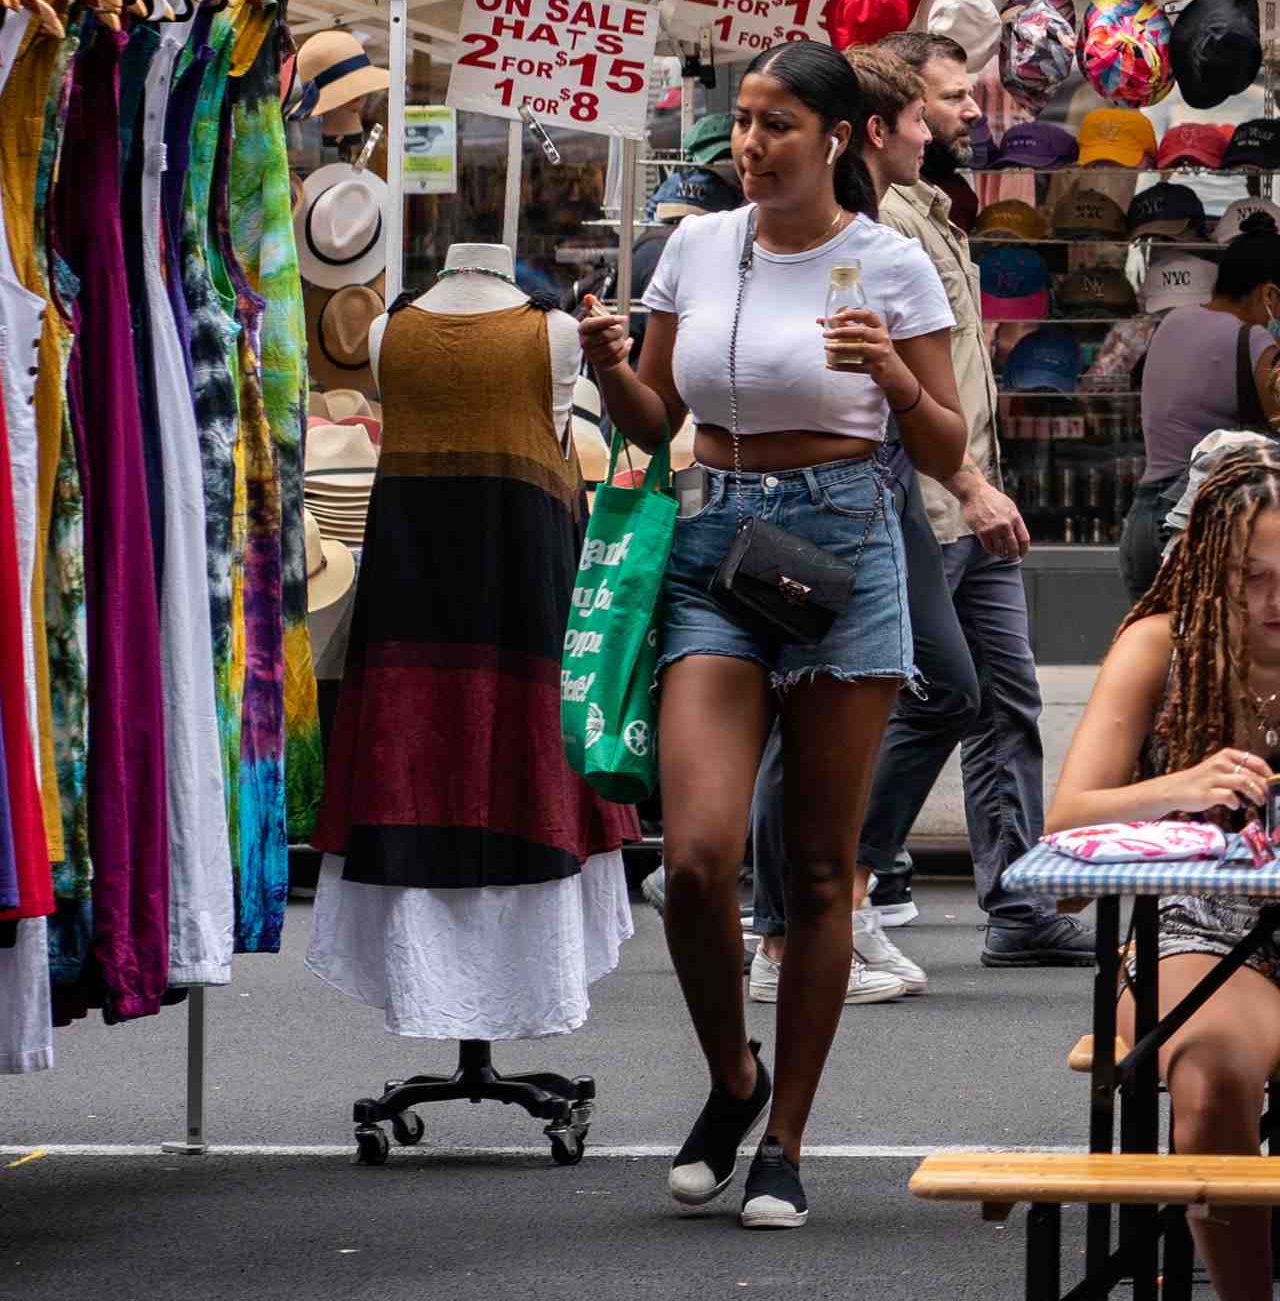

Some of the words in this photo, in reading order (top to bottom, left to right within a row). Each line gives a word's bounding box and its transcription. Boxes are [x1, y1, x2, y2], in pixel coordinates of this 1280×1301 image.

[491, 17, 624, 56] HATS
[714, 14, 734, 42] 1
[738, 31, 773, 50] FOR
[457, 33, 500, 70] 2
[501, 55, 553, 80] FOR
[554, 50, 647, 95] $15
[494, 78, 515, 108] 1
[521, 94, 560, 116] FOR
[559, 87, 600, 124] $8
[1161, 271, 1191, 287] NYC
